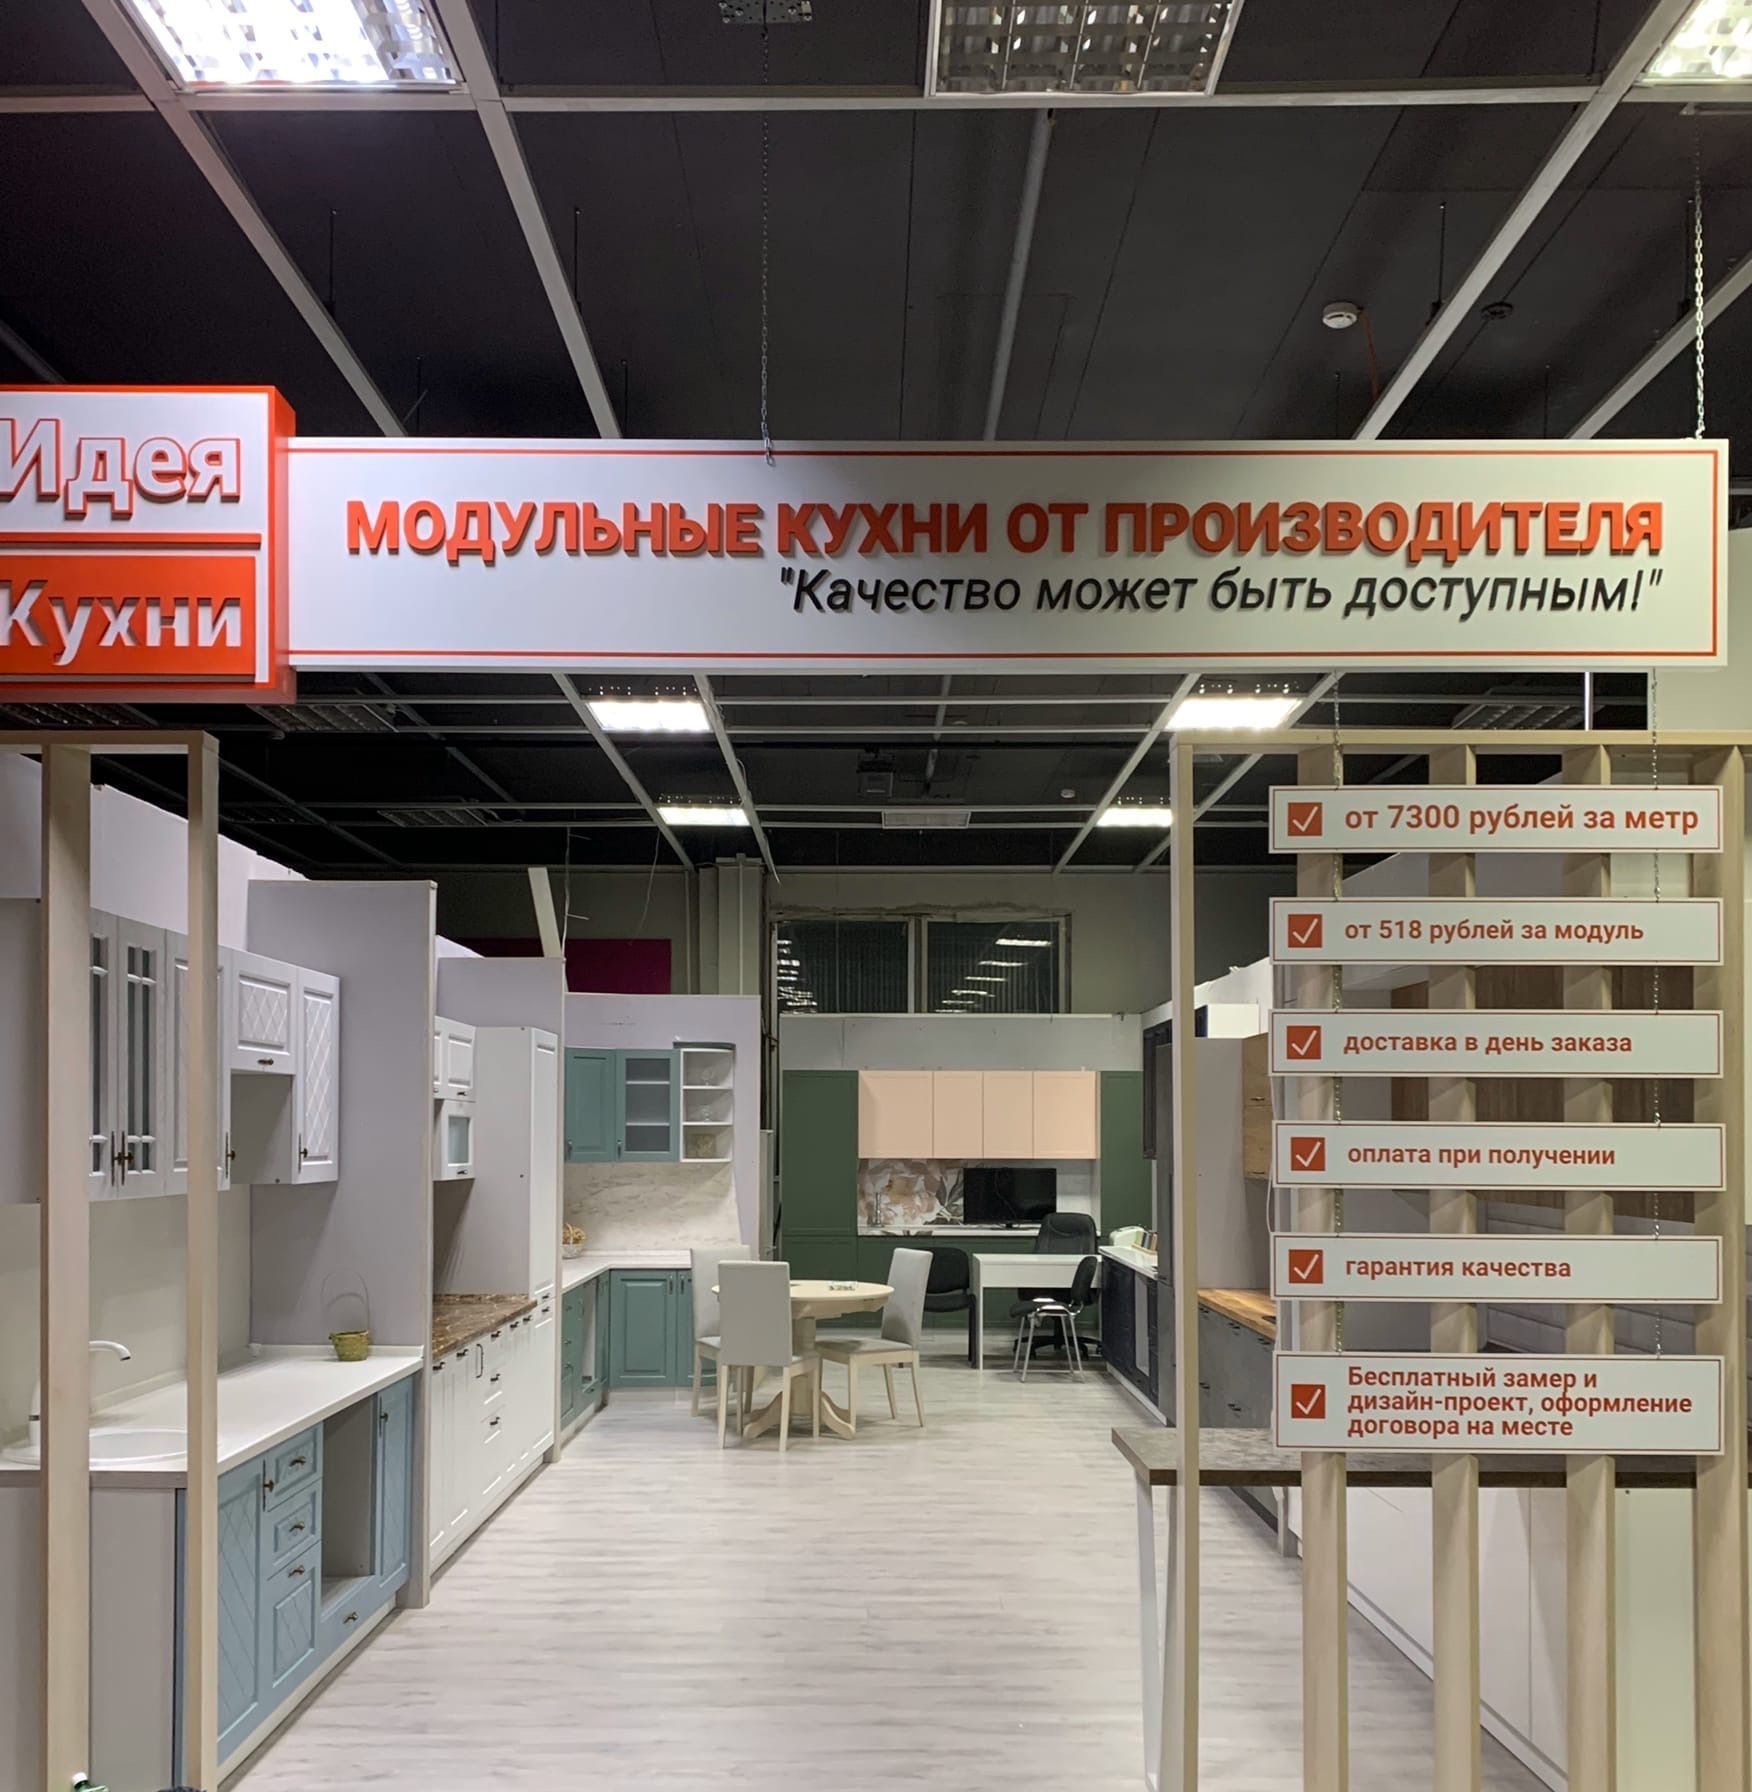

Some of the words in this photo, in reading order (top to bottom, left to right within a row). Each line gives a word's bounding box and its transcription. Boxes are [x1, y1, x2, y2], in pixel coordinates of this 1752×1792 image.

[0, 417, 242, 520] Идея
[346, 500, 762, 566] МОДУЛЬНЫЕ
[777, 503, 988, 557] КУХНИ
[1006, 502, 1089, 555] ОТ
[1105, 502, 1662, 565] ПРОИЗВОДИТЕЛЯ
[780, 566, 1021, 613] "Качество
[1036, 577, 1197, 612] может
[1210, 566, 1332, 611] быть
[1343, 568, 1664, 622] доступным!"
[0, 579, 242, 667] Кухни
[1345, 809, 1378, 830] от
[1387, 805, 1460, 830] 7300
[1469, 803, 1573, 836] рублей
[1583, 809, 1616, 830] за
[1624, 809, 1700, 836] метр
[1345, 922, 1372, 940] от
[1379, 919, 1422, 940] 518
[1430, 918, 1513, 944] рублей
[1521, 922, 1548, 940] за
[1555, 922, 1644, 945] модуль
[1343, 1034, 1457, 1056] доставка
[1464, 1035, 1479, 1052] в
[1485, 1035, 1544, 1056] день
[1551, 1035, 1632, 1053] заказа
[1347, 1147, 1431, 1165] оплата
[1438, 1147, 1482, 1170] при
[1489, 1147, 1616, 1170] получении
[1346, 1258, 1454, 1282] гарантия
[1462, 1259, 1572, 1278] качества
[1348, 1365, 1496, 1389] Бесплатный
[1503, 1370, 1576, 1394] замер
[1584, 1371, 1598, 1389] и
[1347, 1390, 1534, 1417] дизайн-проект,
[1541, 1390, 1693, 1420] оформление
[1347, 1418, 1460, 1440] договора
[1467, 1418, 1494, 1436] на
[1501, 1418, 1574, 1437] месте
